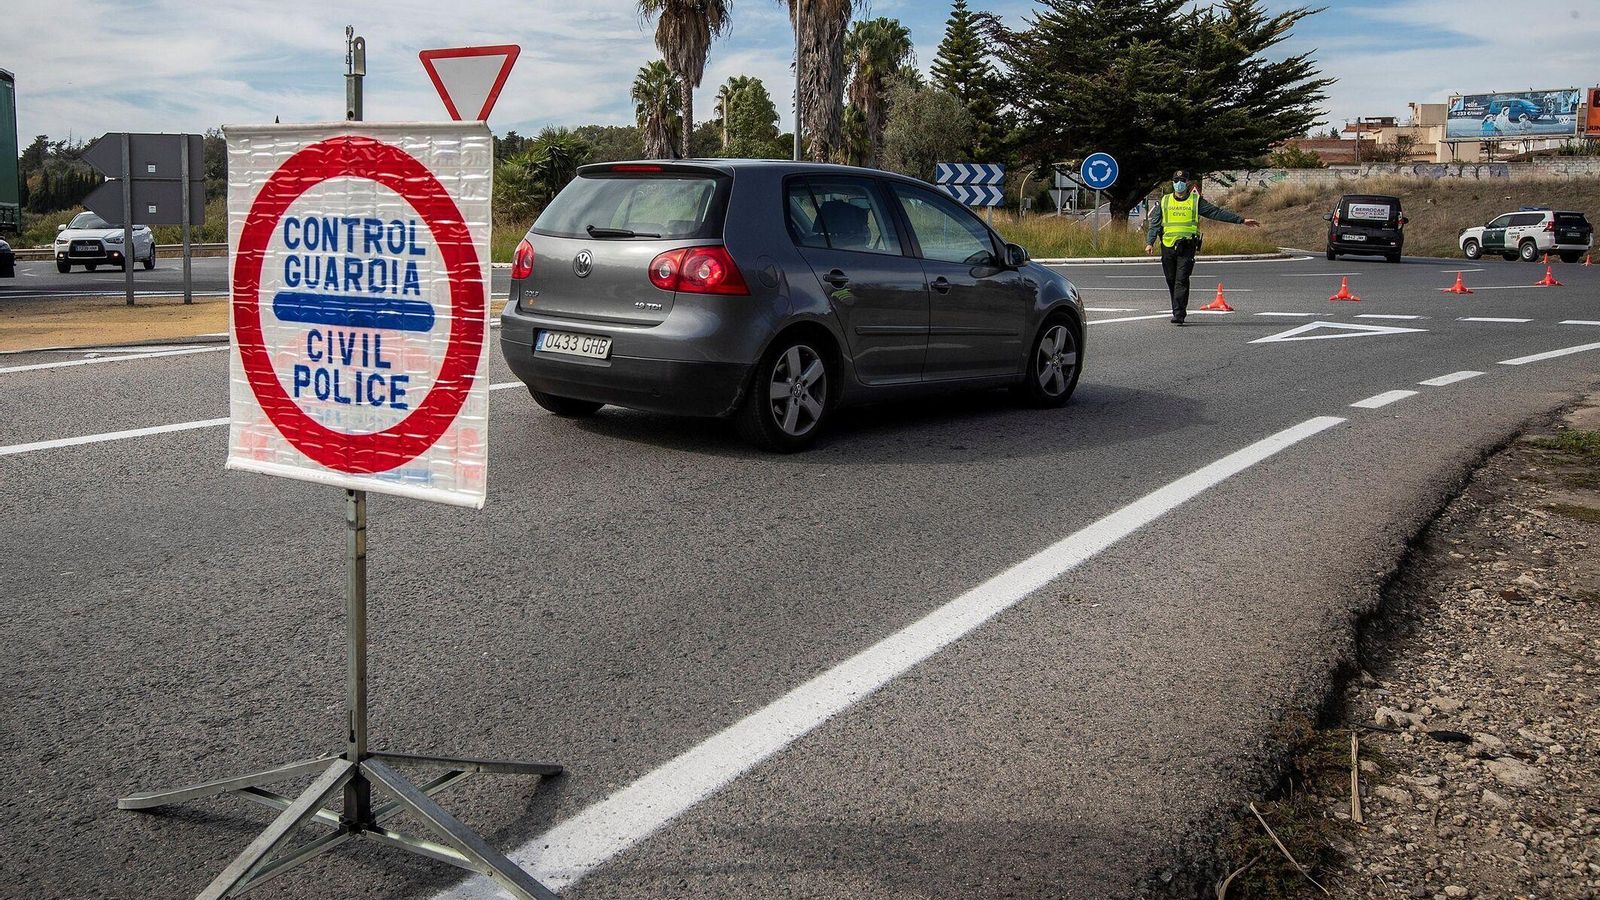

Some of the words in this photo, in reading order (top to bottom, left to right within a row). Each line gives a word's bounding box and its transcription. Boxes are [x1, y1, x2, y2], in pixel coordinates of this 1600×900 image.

[284, 217, 426, 256] CONTROL
[284, 255, 420, 295] GUARDIA
[646, 303, 663, 311] TDI
[307, 329, 391, 368] CIVIL
[545, 333, 579, 350] 0433
[582, 337, 608, 354] GHB
[294, 365, 410, 410] POLICE
